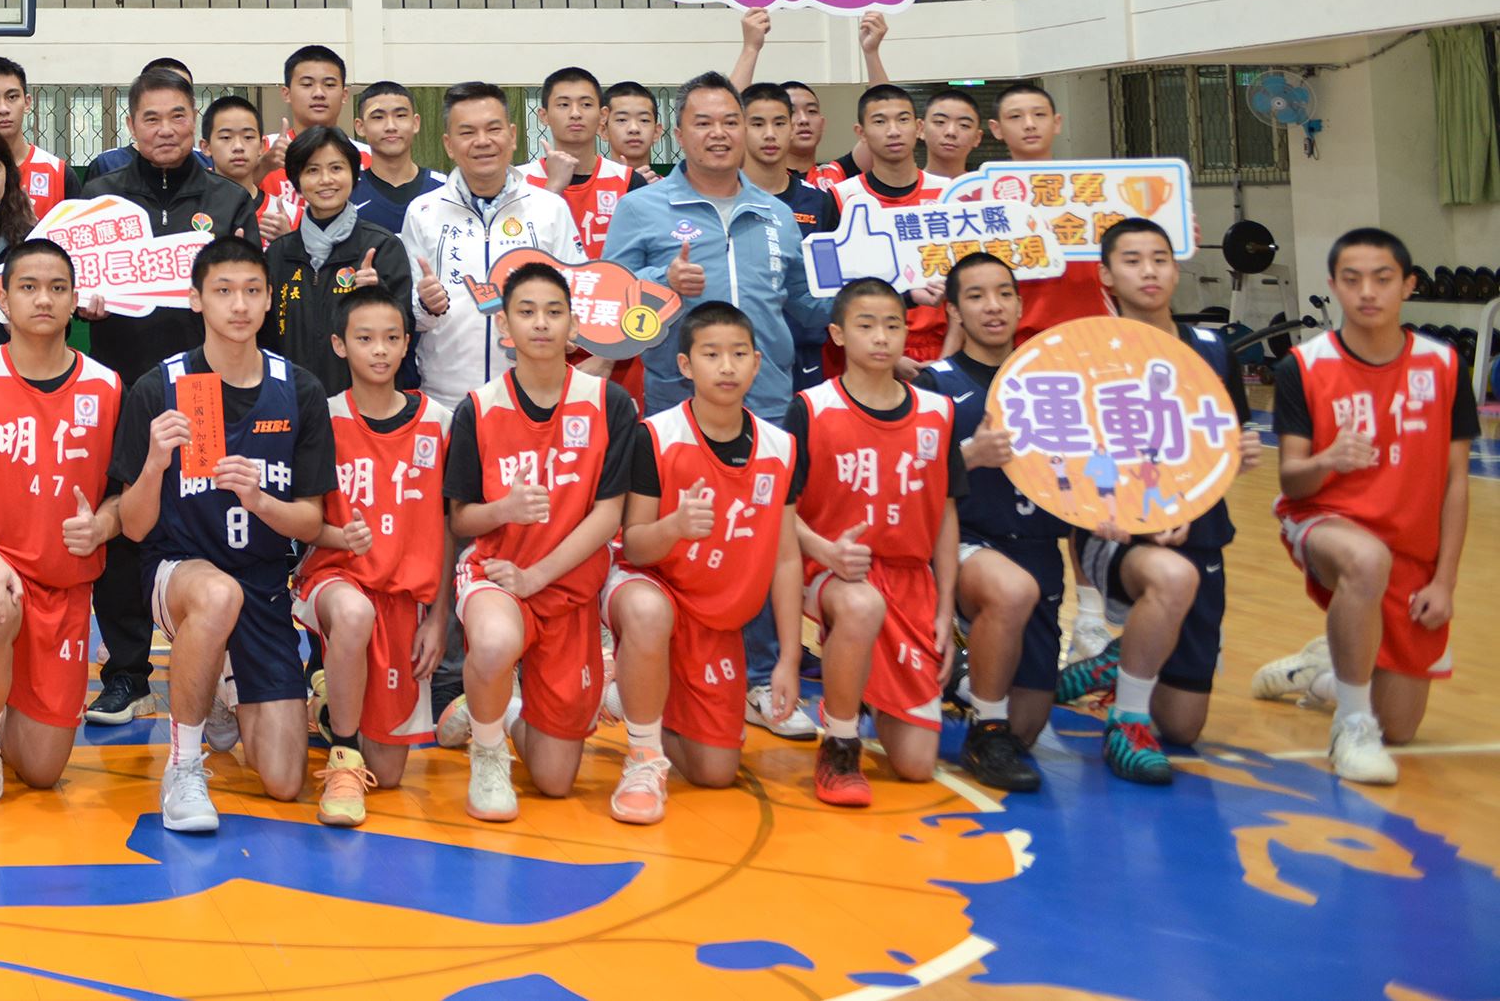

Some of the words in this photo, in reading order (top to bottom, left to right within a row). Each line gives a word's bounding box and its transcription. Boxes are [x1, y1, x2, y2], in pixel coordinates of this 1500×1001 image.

[1030, 173, 1108, 206] 冠軍
[48, 215, 143, 250] 最強應援
[893, 205, 1012, 242] 體育大縣
[448, 225, 464, 285] 余文忠
[635, 313, 646, 333] 1
[252, 419, 292, 434] JHBL
[1333, 393, 1427, 439] 明仁
[335, 458, 423, 507] 明仁
[499, 447, 580, 491] 明仁
[836, 448, 928, 496] 明仁
[29, 475, 64, 497] 47
[226, 507, 249, 549] 8
[381, 514, 393, 535] 8
[865, 504, 900, 526] 15
[687, 542, 724, 569] 48
[59, 640, 84, 661] 47
[897, 643, 923, 670] 15
[704, 658, 736, 685] 48
